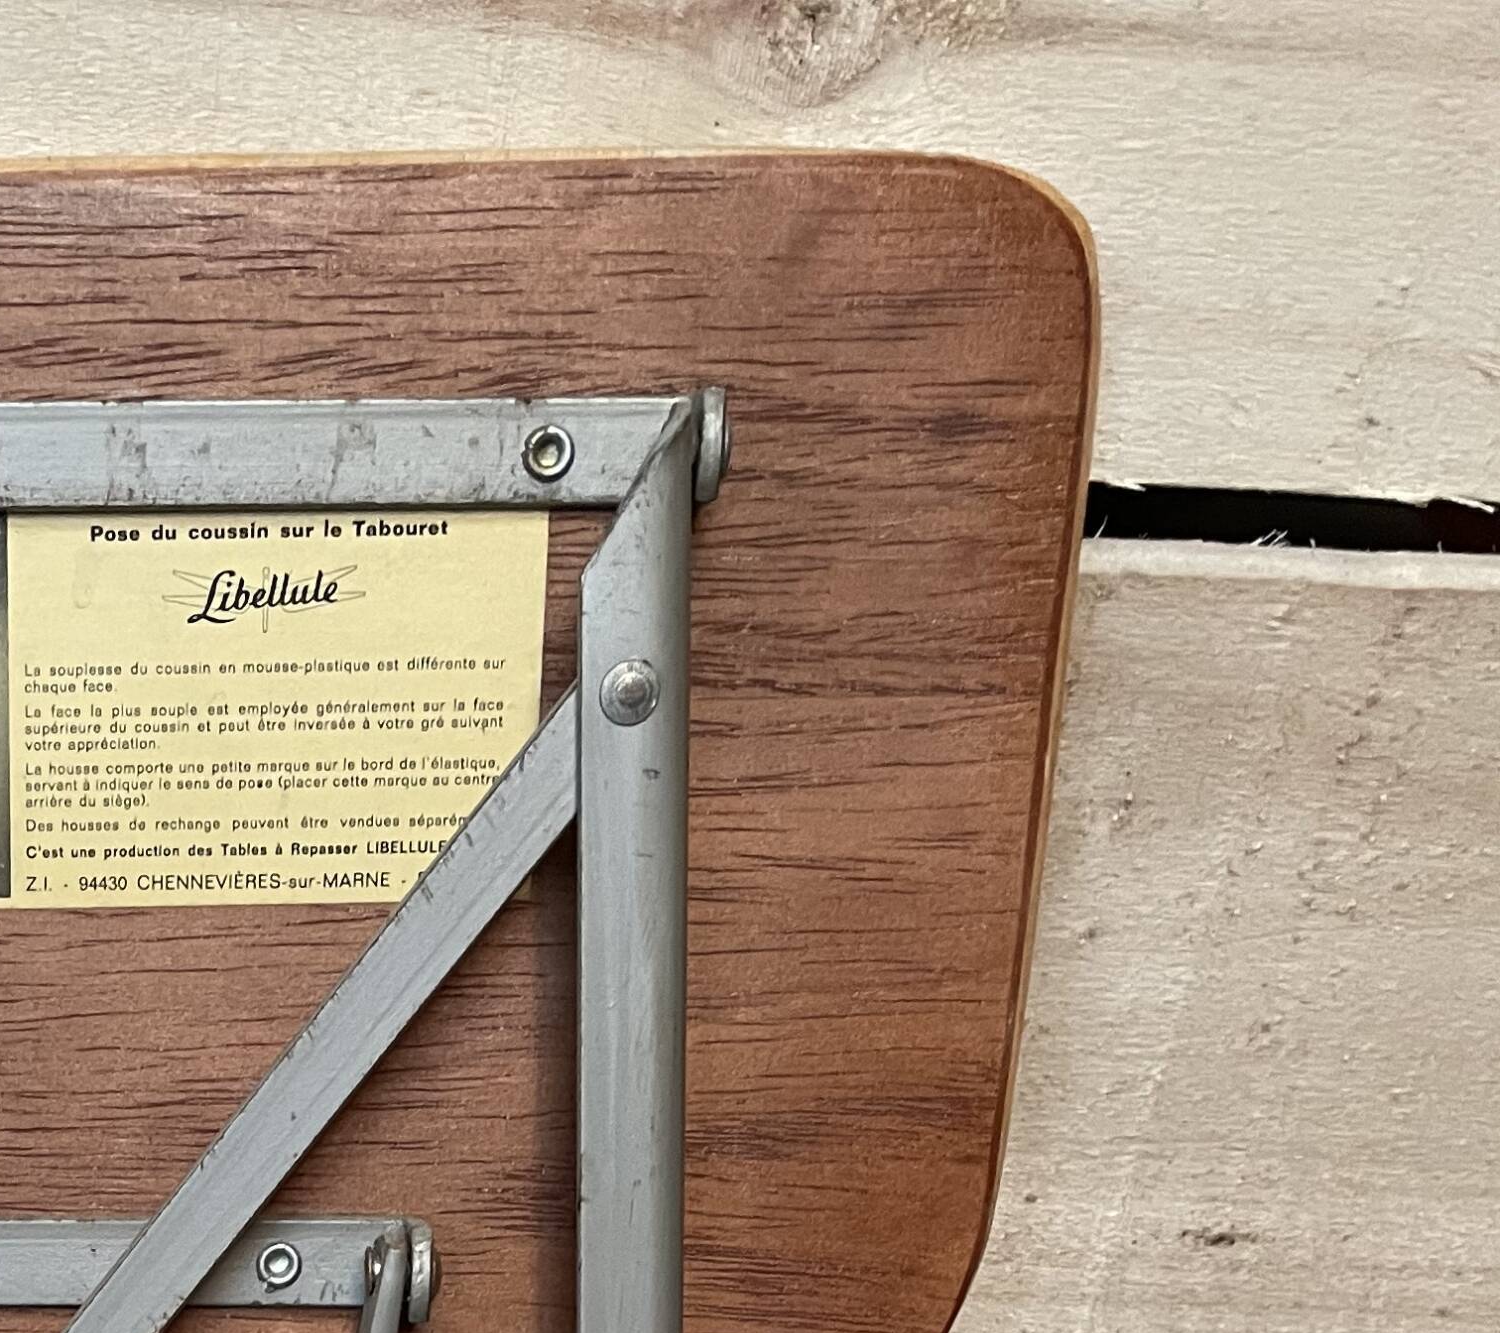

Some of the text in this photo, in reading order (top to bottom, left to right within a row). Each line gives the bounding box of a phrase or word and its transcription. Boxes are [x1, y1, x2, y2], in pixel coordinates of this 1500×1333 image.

[90, 518, 448, 542] Pose du coussin sur le Tabouret
[187, 569, 338, 624] Libellule
[25, 664, 40, 676] La
[50, 662, 122, 679] souplesse
[131, 662, 147, 674] du
[156, 661, 211, 674] coussin
[219, 664, 236, 673] en
[377, 658, 398, 670] est
[407, 656, 476, 670] différente
[484, 659, 506, 668] sur
[24, 680, 76, 696] chaque
[25, 698, 503, 720] La face la plus souple est employée généralement sur la face
[25, 738, 61, 751] votre
[25, 763, 42, 775] La
[49, 762, 99, 775] housse
[106, 761, 173, 777] comporte
[179, 764, 204, 773] une
[212, 760, 251, 776] petite
[257, 762, 310, 775] marque
[316, 762, 338, 771] sur
[343, 758, 355, 770] le
[361, 757, 395, 770] bord
[399, 757, 416, 769] de
[25, 794, 72, 807] arrière
[79, 794, 96, 806] du
[26, 845, 64, 858] C'est
[71, 848, 96, 857] une
[103, 844, 180, 861] production
[188, 844, 212, 856] des
[220, 843, 267, 856] Tables
[275, 843, 283, 855] à
[291, 842, 358, 858] Repasser
[26, 871, 391, 891] Z.I. 94430 CHENNEVIÈRES-sur-MARNE
